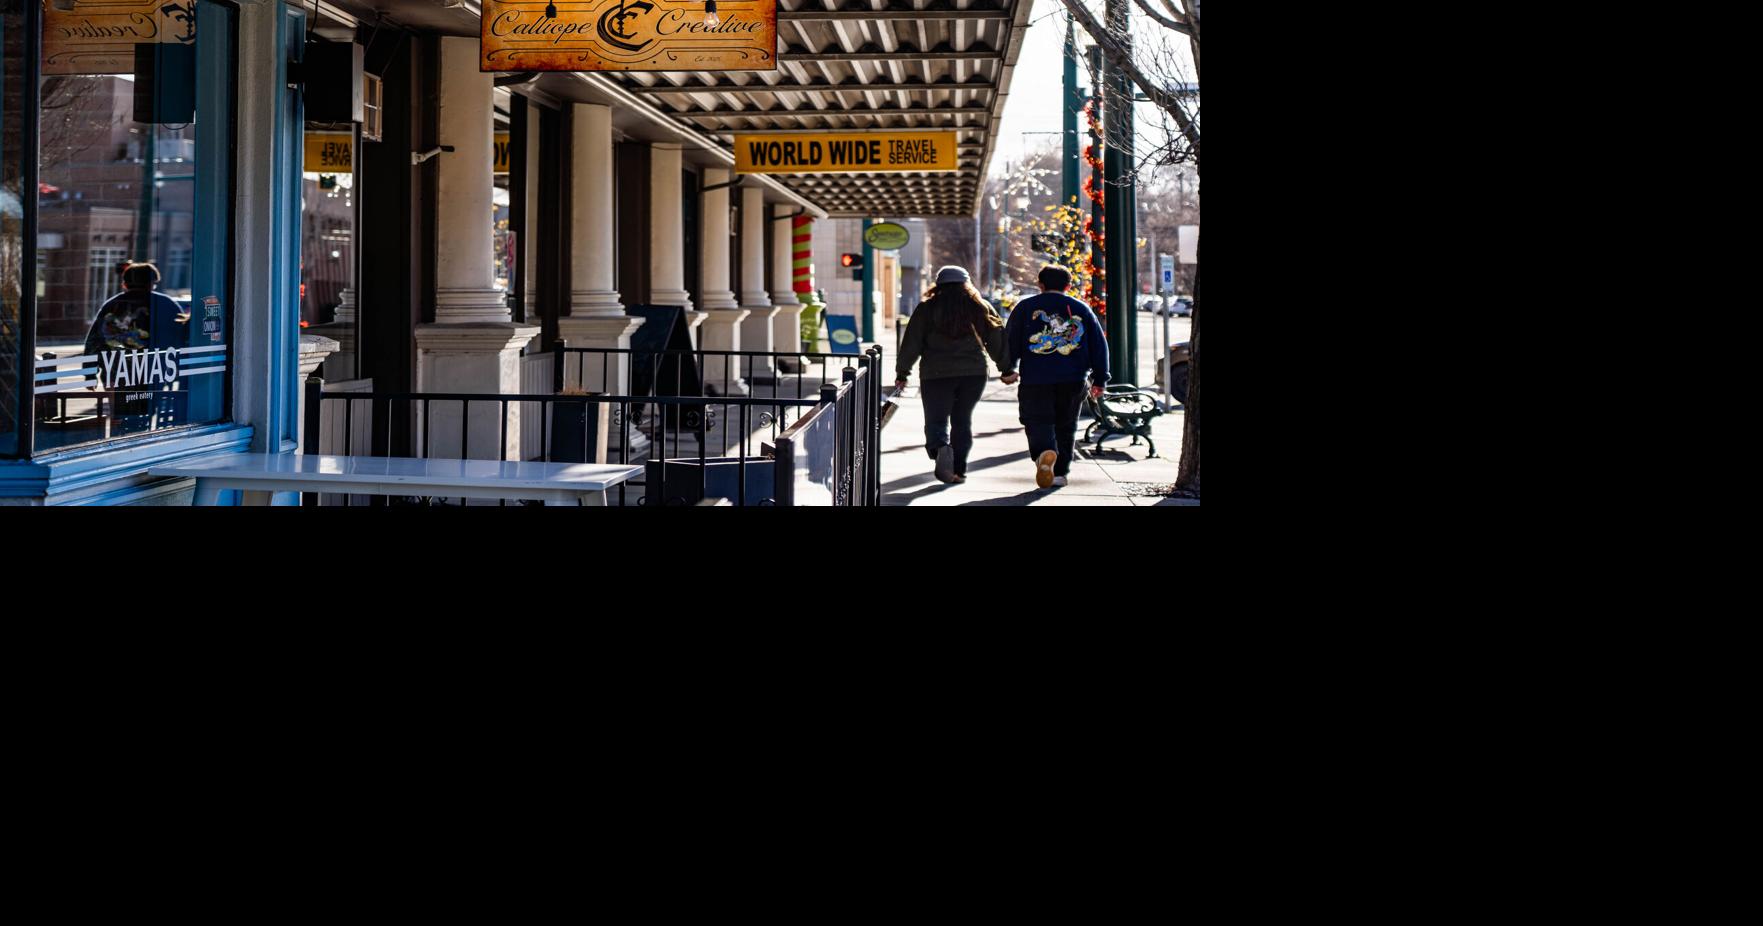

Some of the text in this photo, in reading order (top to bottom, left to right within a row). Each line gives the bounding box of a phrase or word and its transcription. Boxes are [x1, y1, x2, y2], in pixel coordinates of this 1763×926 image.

[491, 10, 592, 44] Calliope
[656, 8, 763, 35] Creative
[750, 140, 881, 166] WORLD WIDE
[888, 139, 936, 152] TRAVEL
[888, 150, 937, 164] SERVICE
[101, 347, 177, 389] YAMAS
[125, 392, 154, 403] greek eatery
